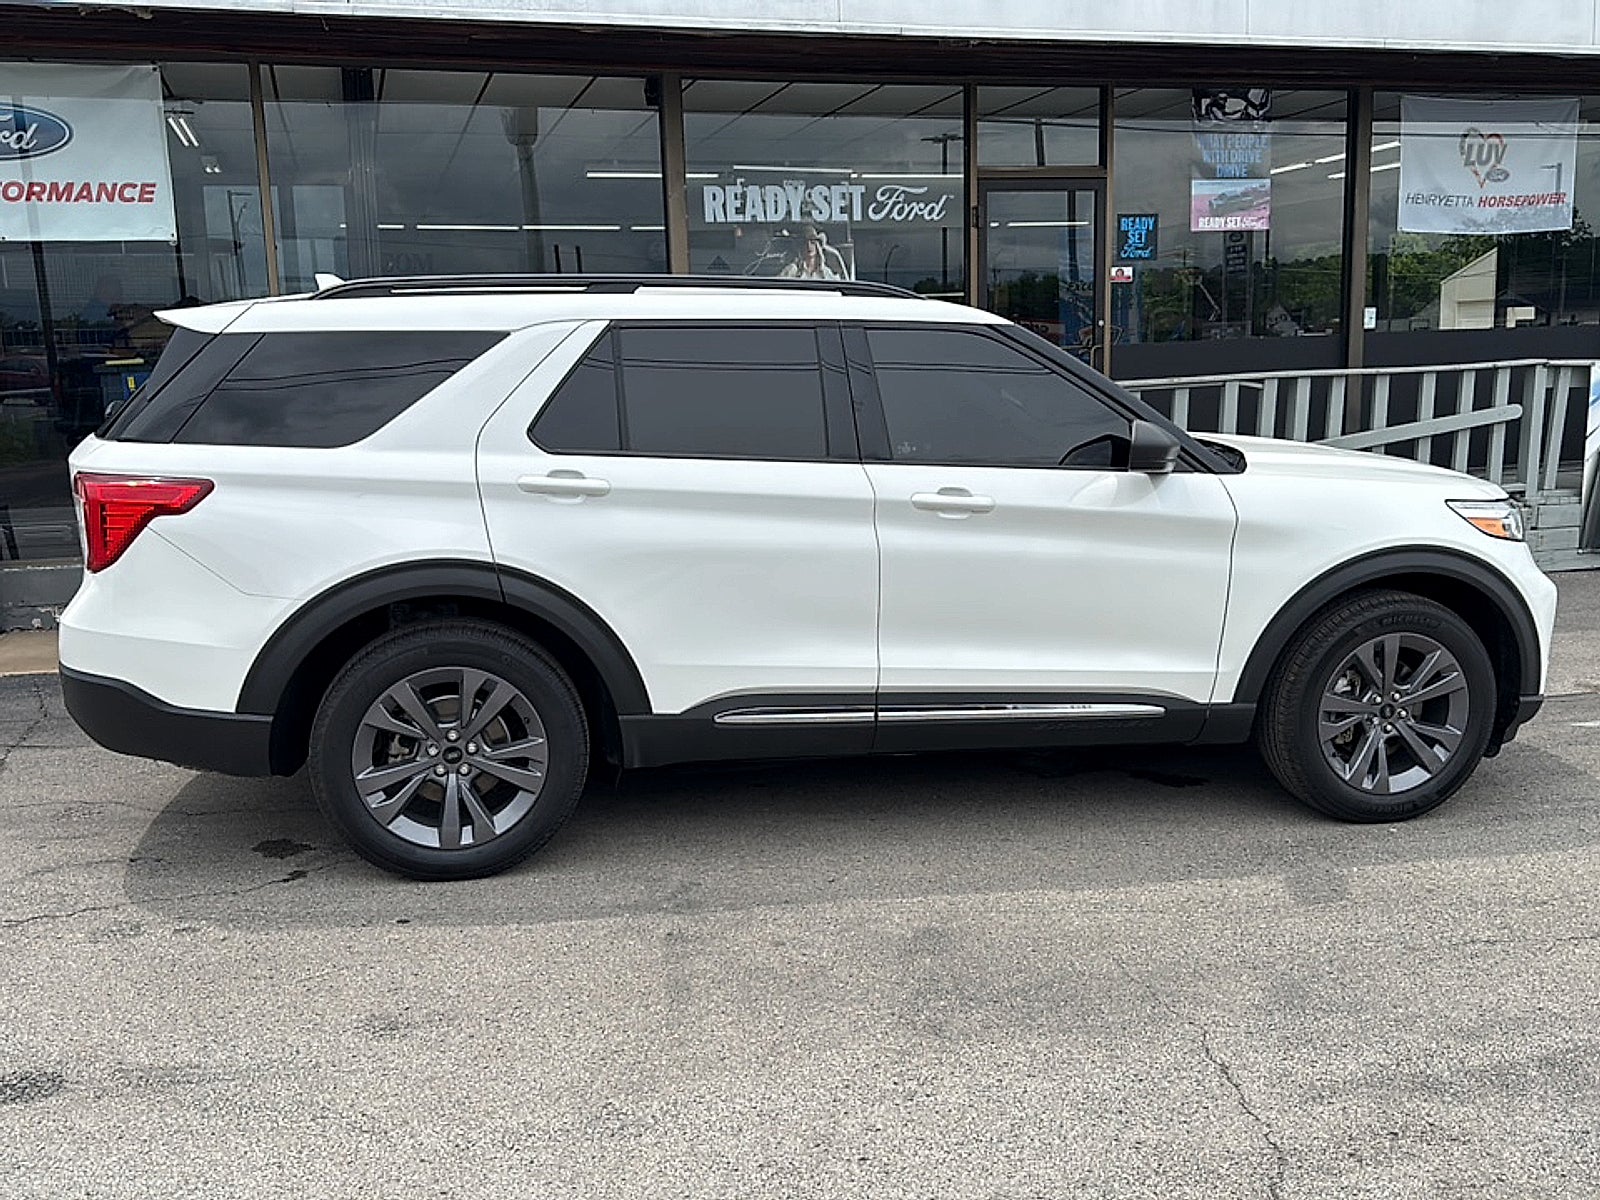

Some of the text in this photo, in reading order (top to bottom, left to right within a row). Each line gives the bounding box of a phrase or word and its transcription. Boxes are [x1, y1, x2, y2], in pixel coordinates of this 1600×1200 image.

[1464, 143, 1507, 166] LUV
[0, 182, 157, 202] ORMANCE
[703, 185, 948, 223] READY SET Ford
[1405, 193, 1567, 208] HENRYETTA HORSEPOWER
[1120, 217, 1155, 231] READY
[1198, 217, 1225, 228] READY
[1226, 217, 1241, 228] SET
[1128, 230, 1147, 244] SET
[1120, 243, 1152, 258] Ford
